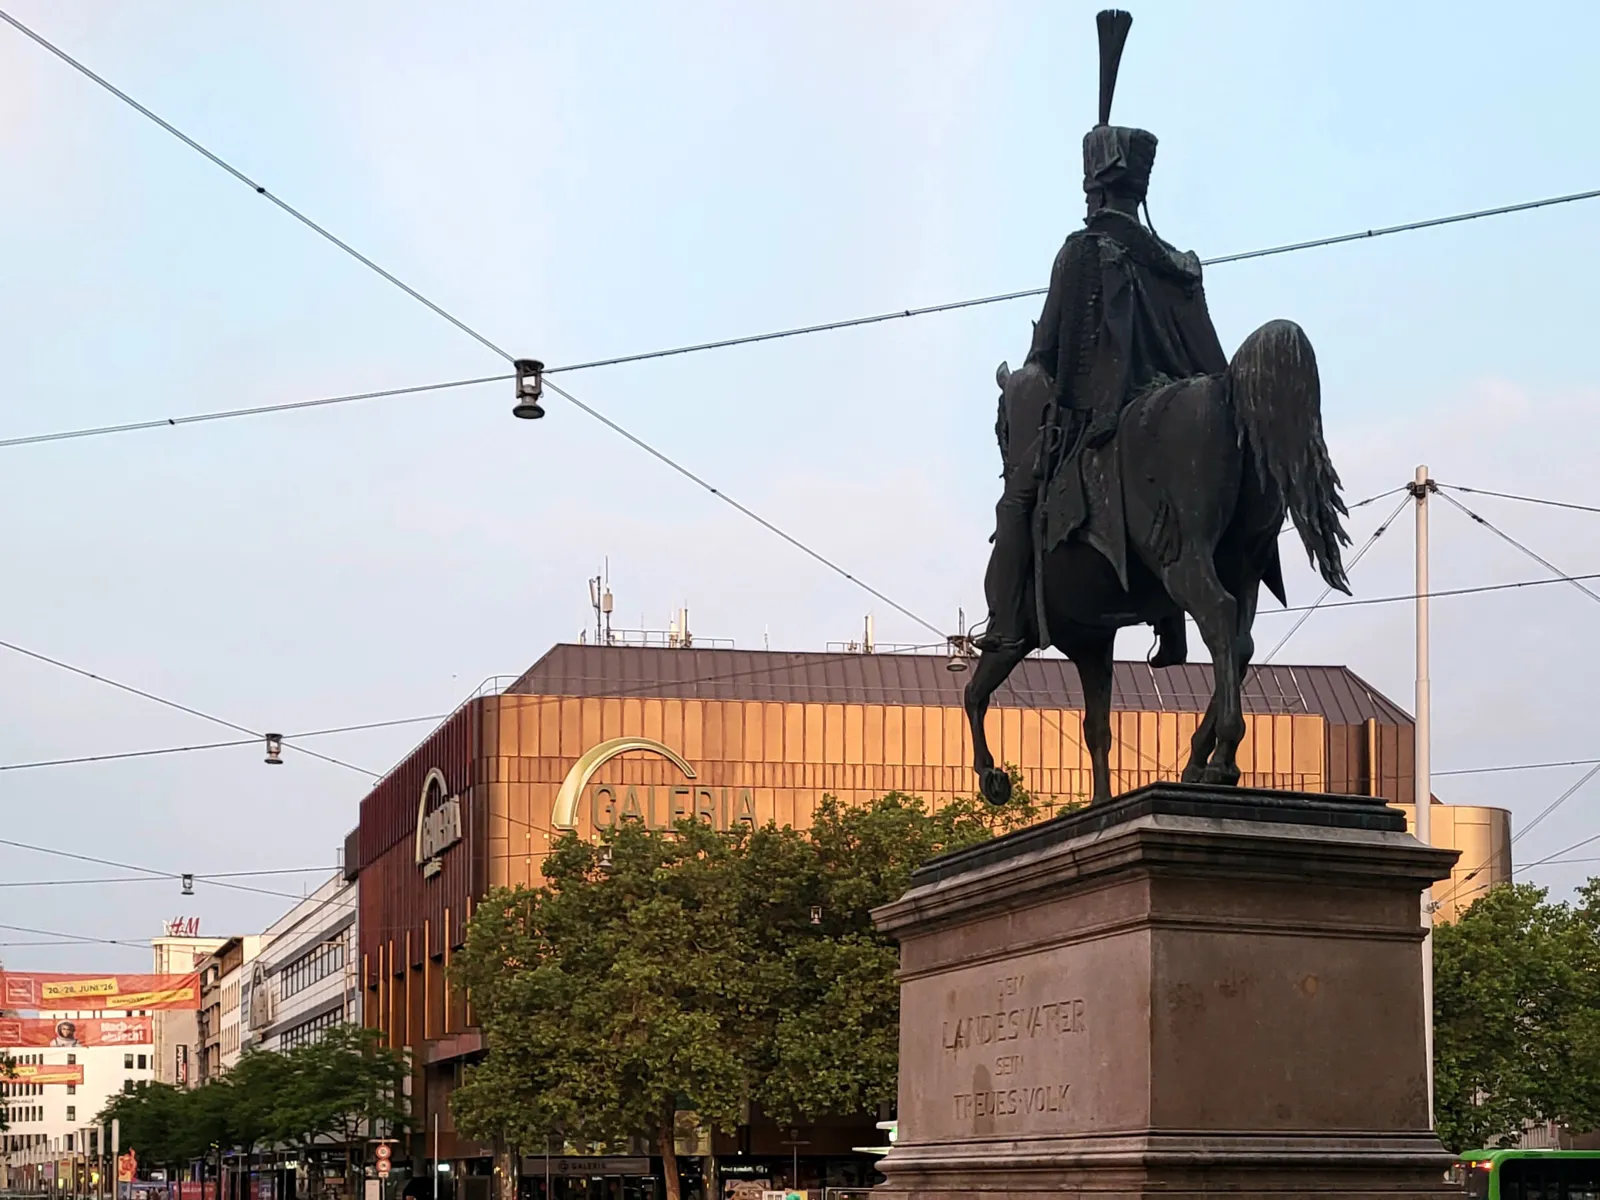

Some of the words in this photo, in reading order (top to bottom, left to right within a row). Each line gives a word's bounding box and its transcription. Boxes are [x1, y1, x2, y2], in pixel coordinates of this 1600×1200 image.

[591, 783, 759, 833] GALERIA
[78, 985, 99, 993] JUNI
[997, 975, 1025, 997] DEM
[942, 999, 1087, 1050] LANDESVATER
[995, 1055, 1024, 1076] SEIN
